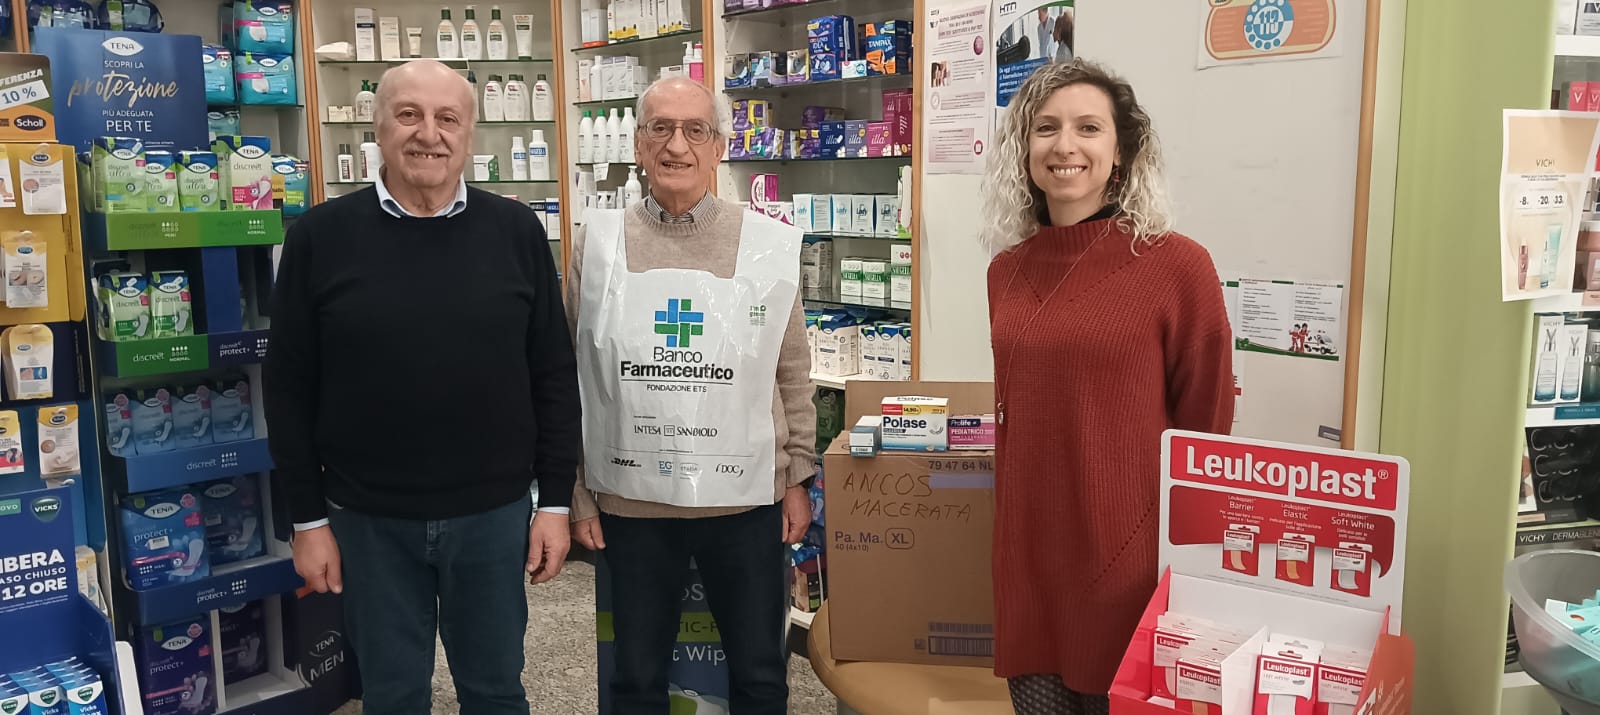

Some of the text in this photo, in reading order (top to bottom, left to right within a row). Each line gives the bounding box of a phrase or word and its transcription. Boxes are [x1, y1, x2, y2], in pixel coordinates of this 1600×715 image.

[111, 42, 135, 50] TENA
[868, 40, 892, 48] TAMPAX
[104, 60, 132, 69] SCOPRI
[67, 70, 180, 108] protezione
[2, 86, 37, 104] 10 %
[16, 118, 44, 127] Scholl
[106, 120, 152, 132] PER TE
[132, 351, 165, 363] discreet
[653, 346, 703, 363] Banco
[620, 361, 734, 380] Farmaceutico
[646, 384, 708, 393] FONDAZIONE ETS
[882, 416, 927, 429] Polase
[634, 425, 661, 435] INTESA
[186, 459, 217, 470] discreet
[659, 461, 673, 469] EG
[721, 465, 740, 474] DOC
[928, 460, 993, 471] 79 47 64 NL
[843, 472, 933, 497] ANCOS
[34, 503, 58, 512] VICKS
[150, 506, 174, 515] TENA
[850, 499, 972, 523] MACERATA
[1229, 501, 1254, 511] Barrier
[1283, 509, 1309, 520] Elastic
[1331, 517, 1375, 530] Soft White
[835, 531, 909, 544] Pa. Ma. XL
[1520, 534, 1545, 543] VICHY
[846, 544, 869, 552] (4x10)
[25, 567, 66, 580] CHIUSO
[2, 577, 68, 601] 12 ORE
[197, 591, 228, 605] protect+
[167, 639, 188, 648] TENA
[315, 636, 335, 654] TENA
[150, 660, 184, 676] protect+
[310, 650, 345, 681] MEN
[80, 704, 97, 713] Vicks
